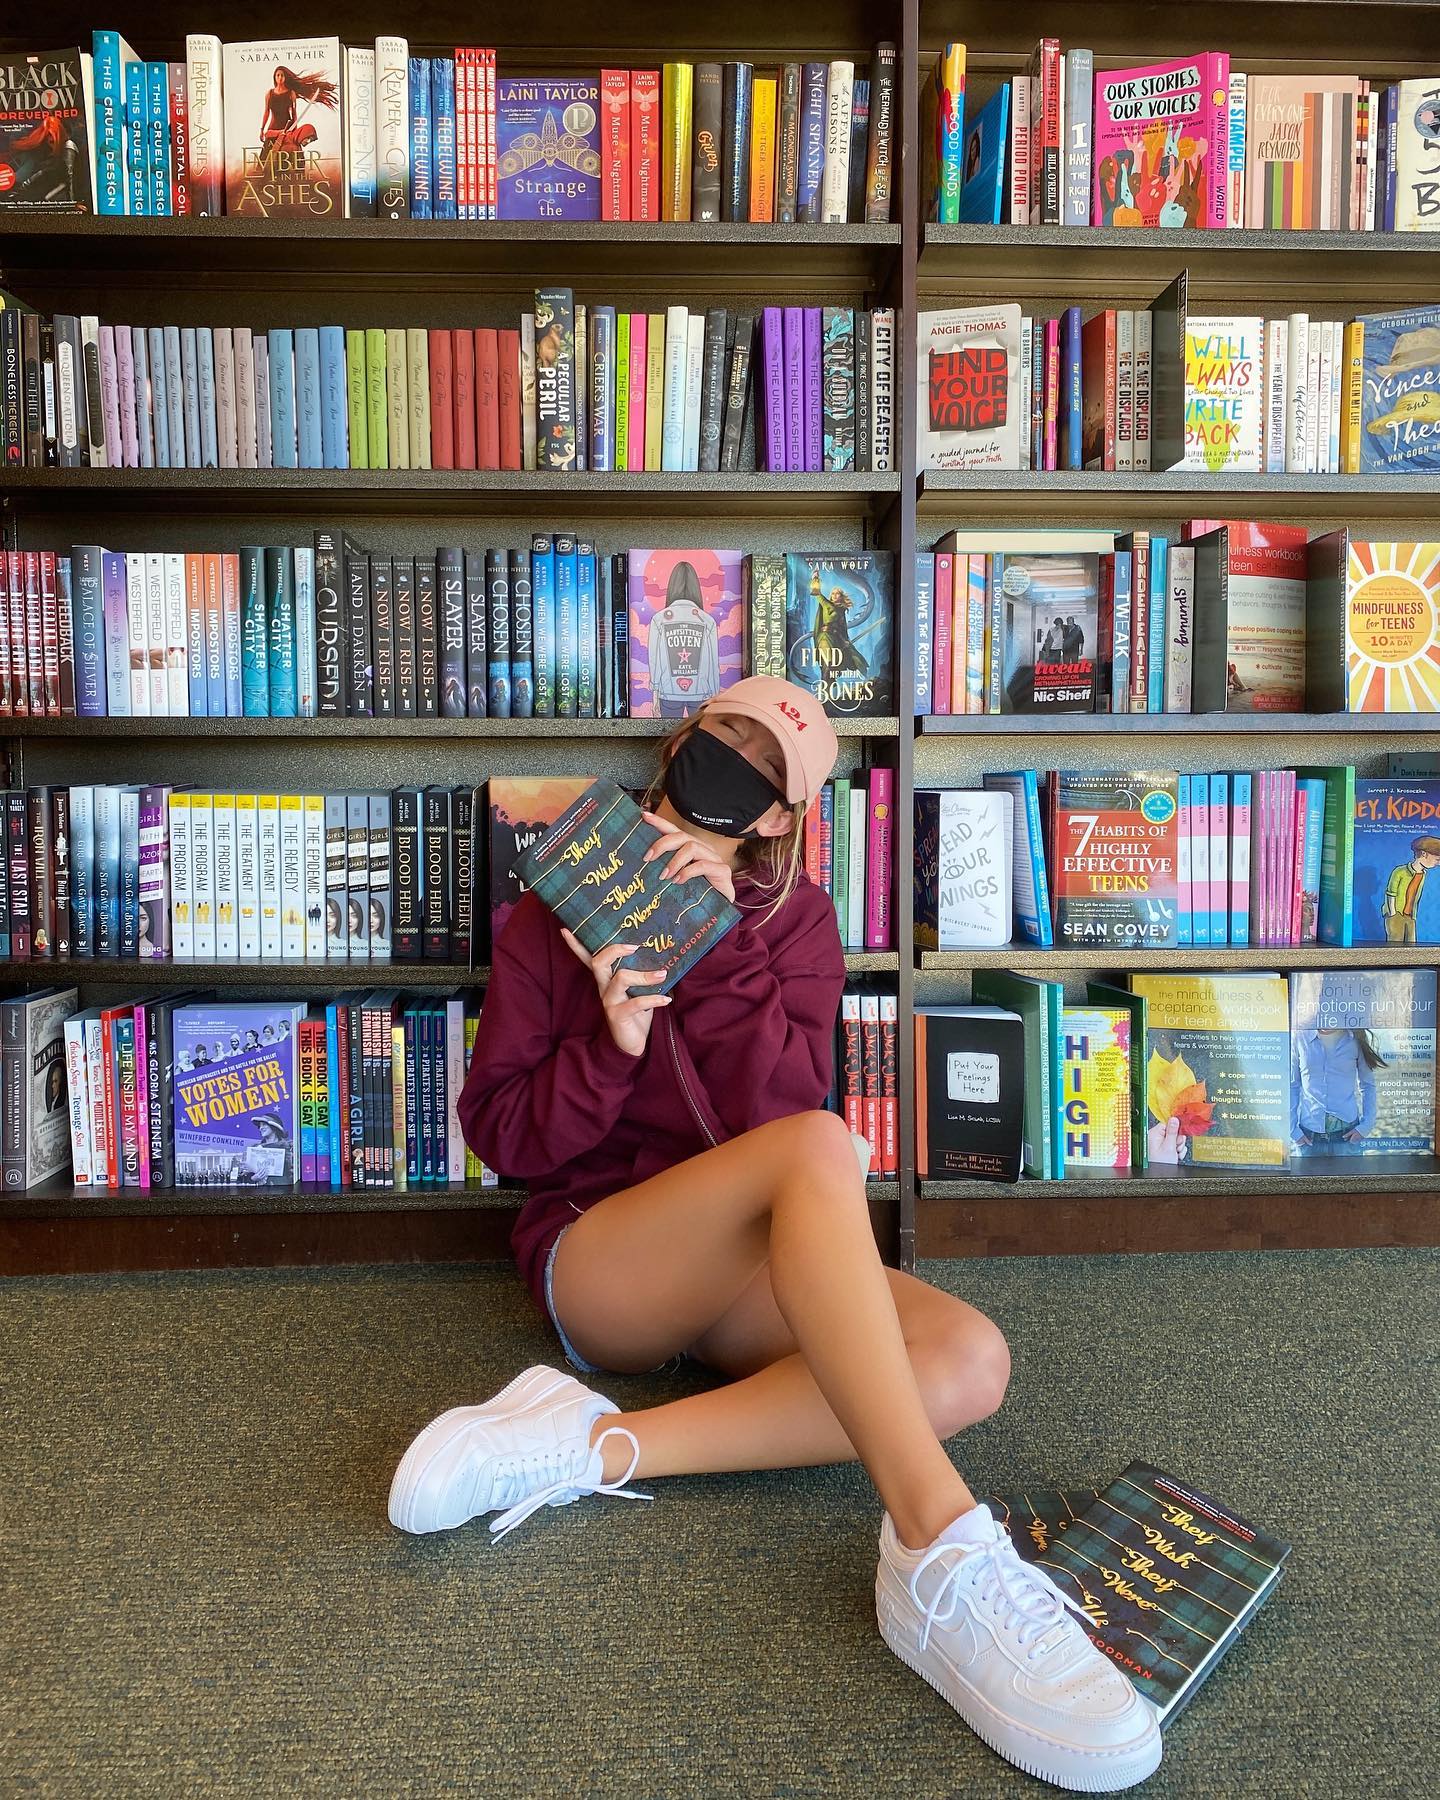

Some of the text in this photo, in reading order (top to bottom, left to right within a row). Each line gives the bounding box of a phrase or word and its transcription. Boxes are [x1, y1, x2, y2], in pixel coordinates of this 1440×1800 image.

[240, 50, 325, 62] SABAA TAHIR
[0, 61, 77, 89] BLACK
[1107, 70, 1198, 100] OUR STORIES,
[500, 88, 598, 101] LAINI TAYLOR
[1113, 96, 1197, 120] OUR VOICES
[103, 56, 116, 208] THIS CRUEL DESIGN
[807, 70, 824, 189] NIGHT SPINNER
[829, 94, 838, 154] POISONS
[840, 100, 848, 155] AFFAIR
[1072, 122, 1088, 148] I
[1229, 109, 1245, 171] STAMPED
[1269, 123, 1302, 141] JASON
[698, 131, 718, 172] Given
[1014, 127, 1028, 206] PERIOD POWER
[1069, 153, 1090, 166] HAVE
[1216, 112, 1226, 220] JANE AGAINST WORLD
[1258, 141, 1301, 159] REYNOLDS
[611, 117, 621, 220] Muse Nightmares
[1071, 173, 1087, 181] THE
[234, 181, 333, 217] ASHES
[515, 179, 586, 196] Strange
[1069, 186, 1090, 196] RIGHT
[1073, 200, 1086, 215] TO
[931, 320, 1006, 335] ANGIE THOMAS
[930, 348, 1007, 375] FIND
[1192, 336, 1250, 360] WILL
[7, 348, 18, 443] BONELESS MERCIES
[539, 367, 557, 421] PERIL
[558, 363, 570, 422] PECULIAR
[876, 327, 890, 456] CITY OF BEASTS
[930, 375, 1007, 400] YOUR
[772, 389, 782, 460] UNLEASHED
[930, 400, 1007, 431] VOICE
[937, 446, 963, 463] guided
[961, 447, 989, 460] journal
[990, 445, 1000, 453] for
[1388, 453, 1404, 463] VAN
[1406, 447, 1429, 459] GOGH
[808, 560, 869, 571] SARA WOLF
[377, 590, 388, 630] NOW
[446, 580, 463, 651] SLAYER
[493, 580, 509, 654] CHOSEN
[1114, 591, 1131, 658] TWEAK
[1135, 550, 1147, 695] UNDEFEATED
[1174, 587, 1189, 647] Spinning
[1353, 602, 1424, 615] MINDFULNESS
[1381, 618, 1415, 629] TEENS
[82, 576, 97, 697] PALACE OF SILVER
[190, 608, 201, 678] IMPOSTORS
[245, 619, 255, 653] CITY
[255, 604, 266, 669] SHATTER
[317, 588, 340, 699] CURSED
[538, 597, 547, 697] WHEN WE WERE LOST
[667, 636, 702, 648] COVEN
[1370, 636, 1388, 646] 10
[378, 649, 391, 685] RISE
[801, 648, 843, 669] FIND
[1034, 657, 1092, 674] tweak
[811, 680, 874, 712] BONES
[1034, 690, 1091, 702] Nic Sheff
[564, 831, 601, 867] They
[1068, 815, 1099, 856] 7
[1095, 826, 1145, 836] HABITS
[1149, 826, 1168, 836] OF
[1090, 843, 1152, 855] HIGHLY
[174, 822, 186, 891] THE PROGRAM
[307, 825, 320, 895] THE EPIDEMIC
[587, 854, 624, 887] Wish
[1063, 857, 1172, 872] EFFECTIVE
[11, 844, 28, 916] THE LAST STAR
[399, 836, 412, 925] BLOOD HEIR
[607, 876, 645, 911] They
[1088, 875, 1149, 892] TEENS
[625, 898, 659, 929] Were
[1064, 923, 1170, 936] SEAN COVEY
[680, 915, 718, 955] GOODMAN
[1158, 989, 1264, 1000] the mindfulness &
[1298, 1000, 1433, 1015] emotions run your
[150, 1058, 160, 1099] GLORIA
[179, 1059, 284, 1104] VOTES FOR
[301, 1029, 313, 1127] THIS BOOK IS GAY
[954, 1060, 994, 1070] Put Your
[957, 1072, 991, 1084] Feelings
[185, 1079, 290, 1128] WOMEN!
[963, 1083, 985, 1094] Here
[1066, 1035, 1090, 1158] HIGH
[122, 1042, 136, 1172] LIFE INSIDE MY MIND
[150, 1103, 162, 1161] STEINEM
[179, 1133, 245, 1147] WINIFRED CONKLING
[1162, 1506, 1220, 1546] They
[1142, 1525, 1198, 1569] Wish
[1122, 1548, 1180, 1593] They
[1102, 1568, 1160, 1610] Were
[1088, 1635, 1152, 1679] GOODMAN
